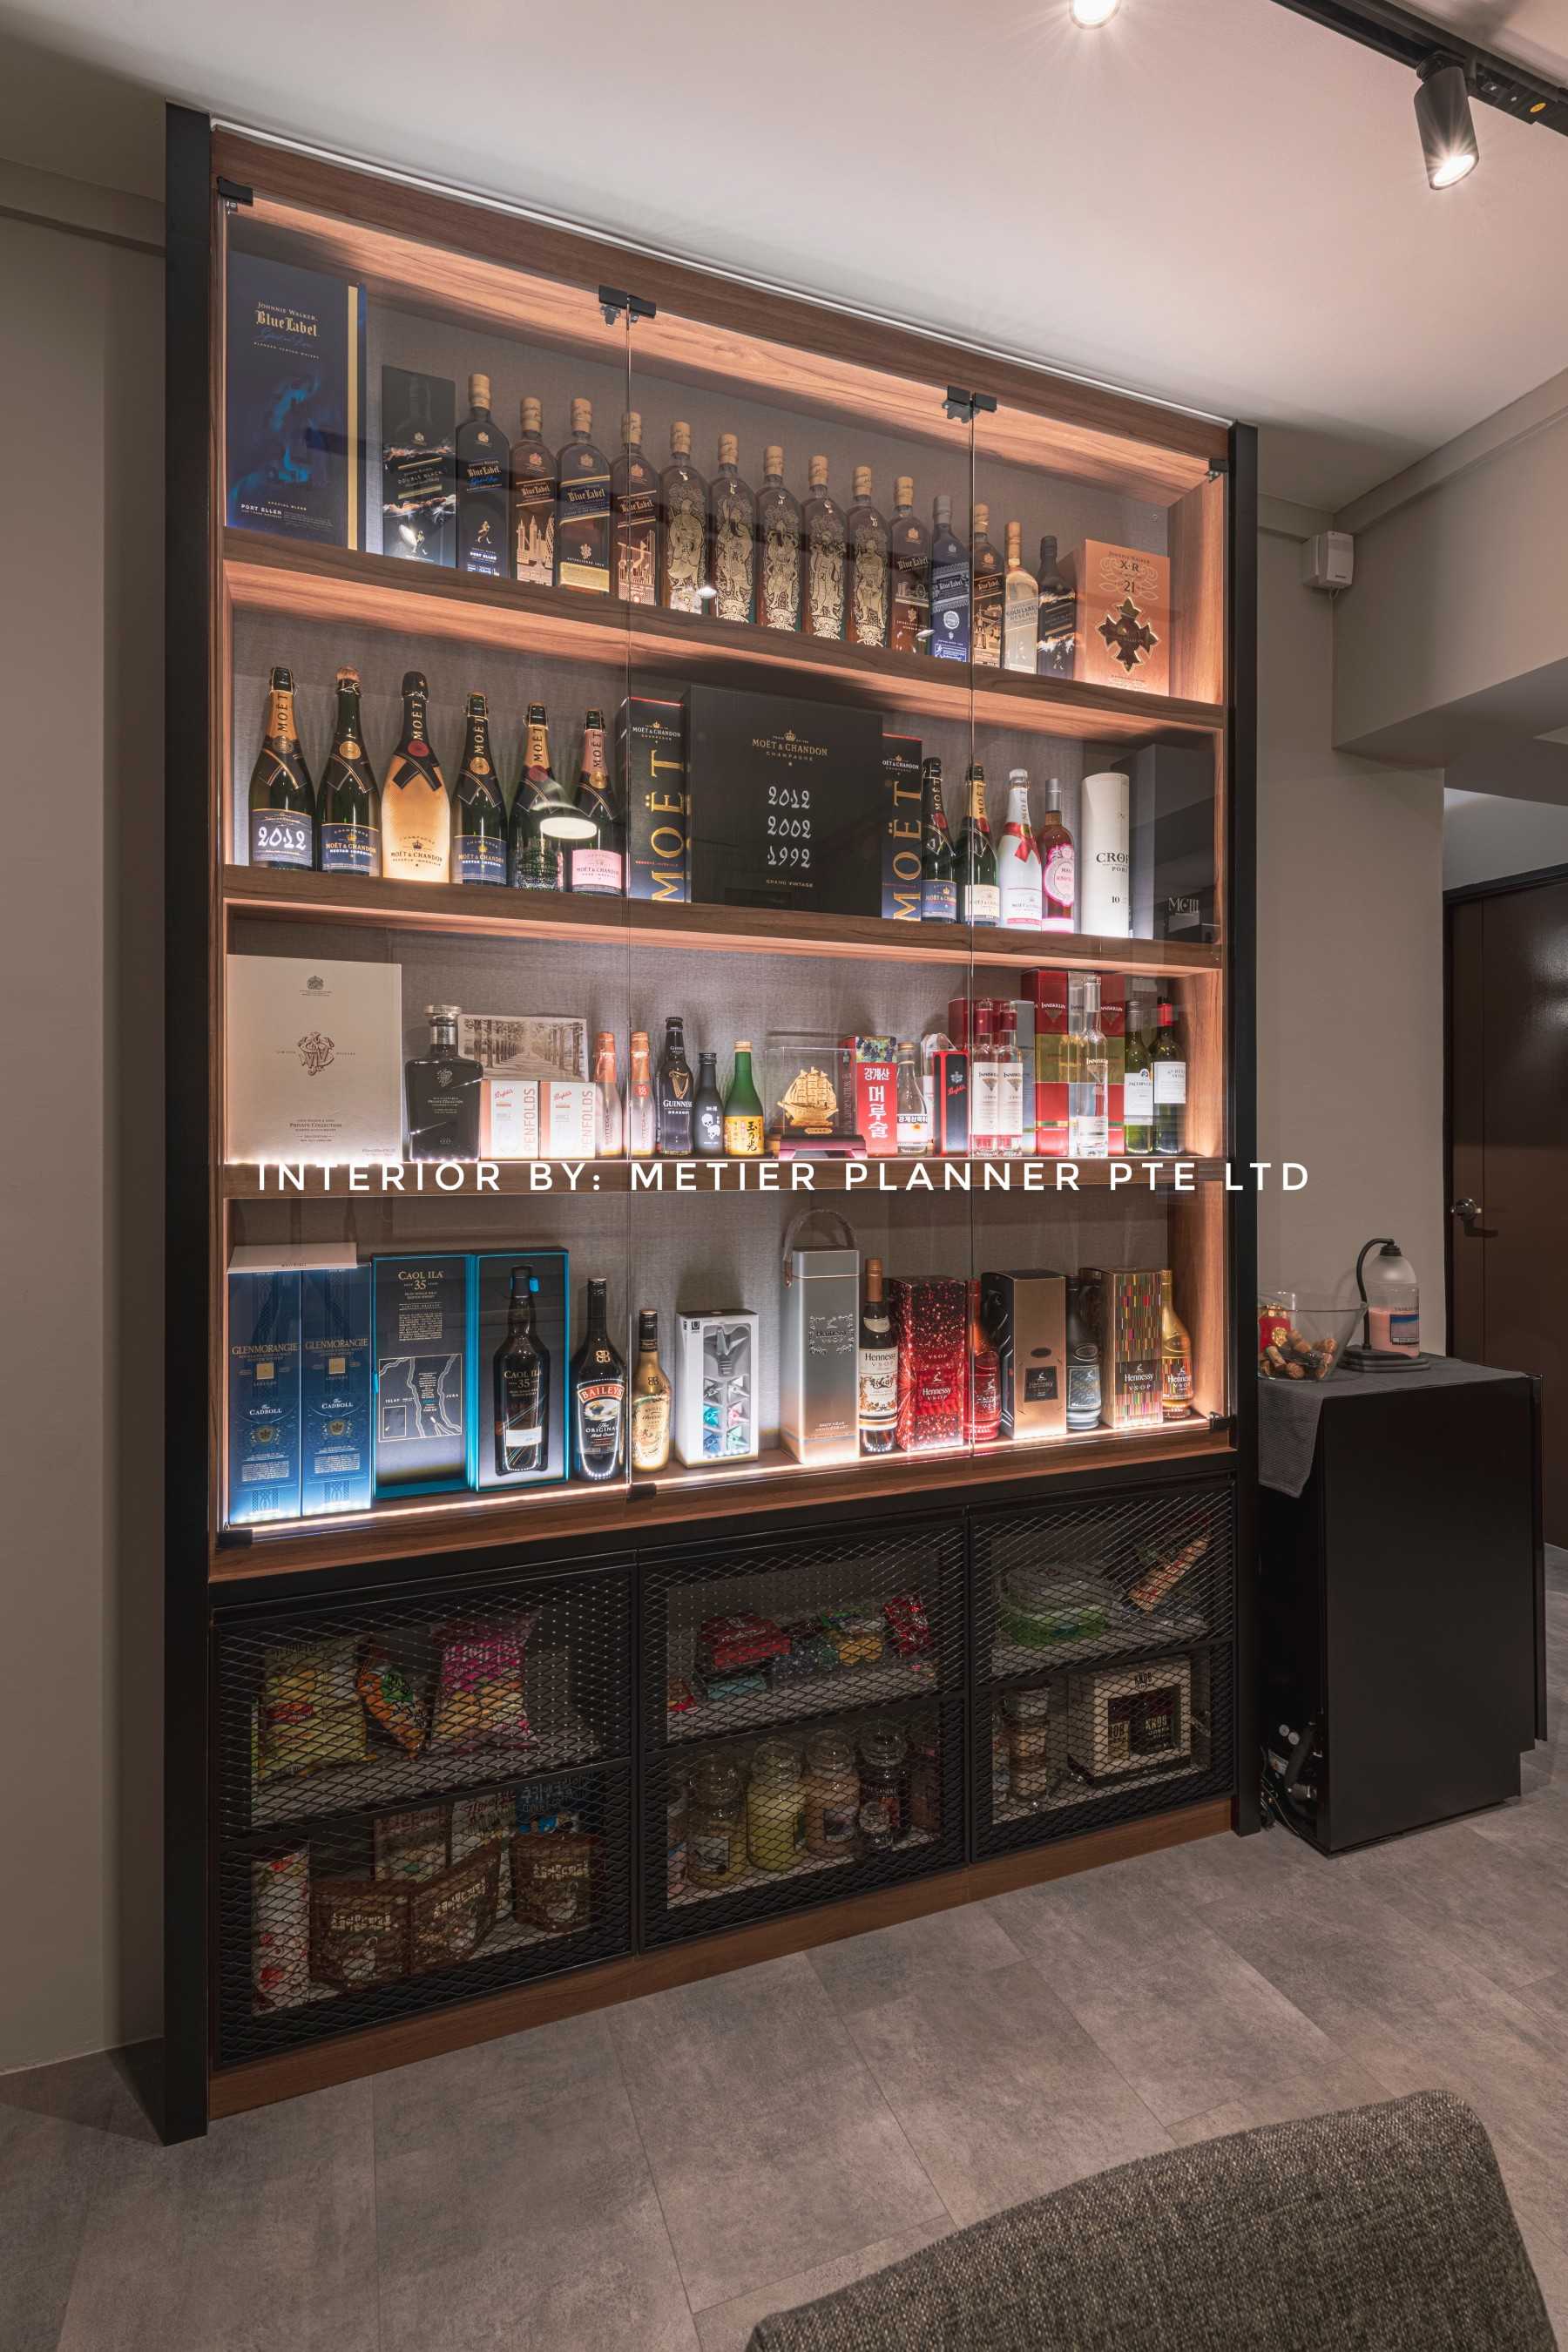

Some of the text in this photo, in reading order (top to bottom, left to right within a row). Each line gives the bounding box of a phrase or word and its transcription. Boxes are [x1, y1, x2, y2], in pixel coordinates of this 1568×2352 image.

[258, 301, 316, 321] JOHNNIE WALKER
[255, 310, 286, 328] Blue
[285, 317, 317, 337] Label
[522, 485, 551, 497] Blue Label
[567, 488, 606, 502] Blue Label
[241, 504, 260, 512] PORT
[260, 506, 282, 516] ELLEN
[1124, 579, 1135, 593] 21
[652, 728, 681, 738] CHANDON
[752, 738, 778, 749] MOËT
[785, 744, 828, 756] CHANDON
[767, 786, 811, 809] 2012
[645, 749, 685, 902] MOËT
[767, 815, 812, 839] 2002
[257, 826, 307, 851] 2012
[767, 845, 812, 868] 1992
[887, 781, 923, 923] MOËT
[868, 1085, 889, 1139] 머루술
[523, 1087, 537, 1152] PENFOLDS
[397, 1269, 443, 1281] CAOL ILA
[414, 1280, 427, 1290] 35
[231, 1342, 299, 1355] GLENMORANGIE
[305, 1337, 369, 1351] GLENMORANGIE
[504, 1370, 529, 1379] CAOL
[1124, 1372, 1155, 1382] Hennessy
[517, 1378, 531, 1389] 35
[581, 1386, 625, 1400] BAILEYS
[922, 1386, 952, 1396] Hennessy
[249, 1408, 283, 1416] CADBOLL
